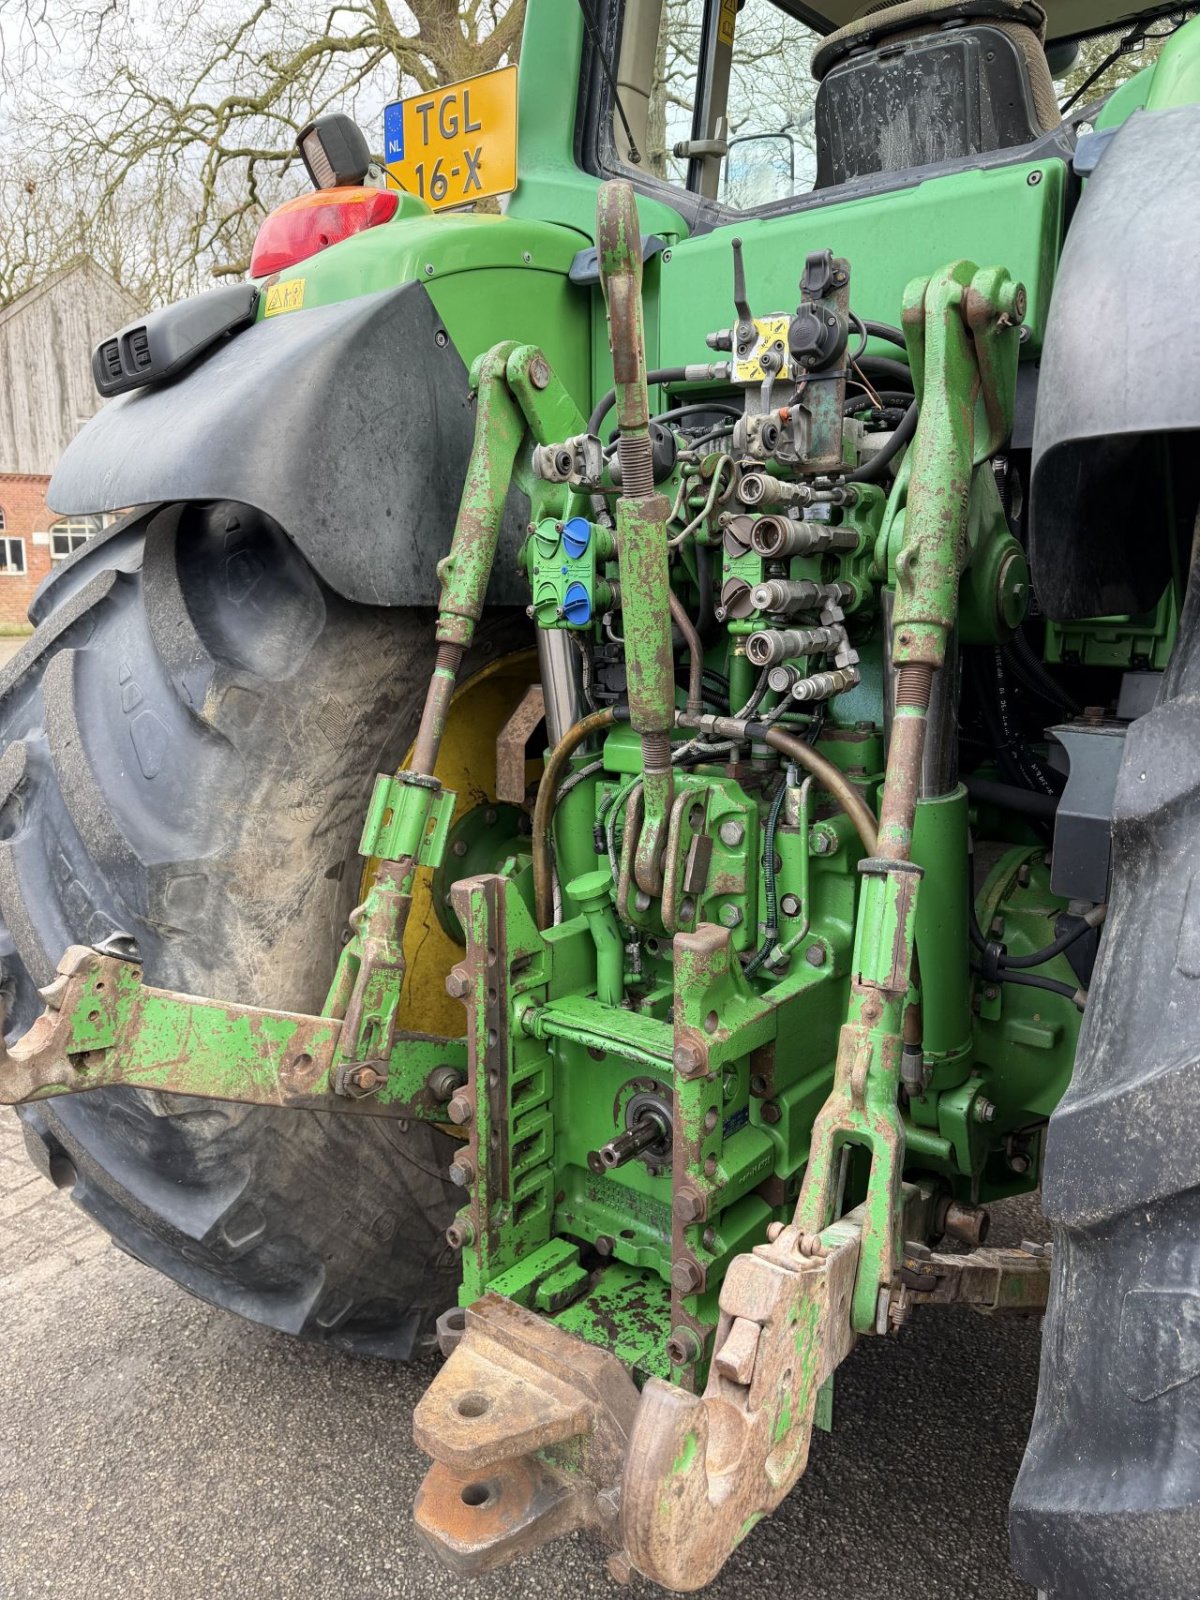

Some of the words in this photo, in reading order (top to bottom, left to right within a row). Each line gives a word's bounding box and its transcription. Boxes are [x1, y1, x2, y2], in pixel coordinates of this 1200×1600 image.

[416, 90, 482, 146] TGL
[389, 139, 402, 154] NL
[415, 147, 482, 201] 16-X
